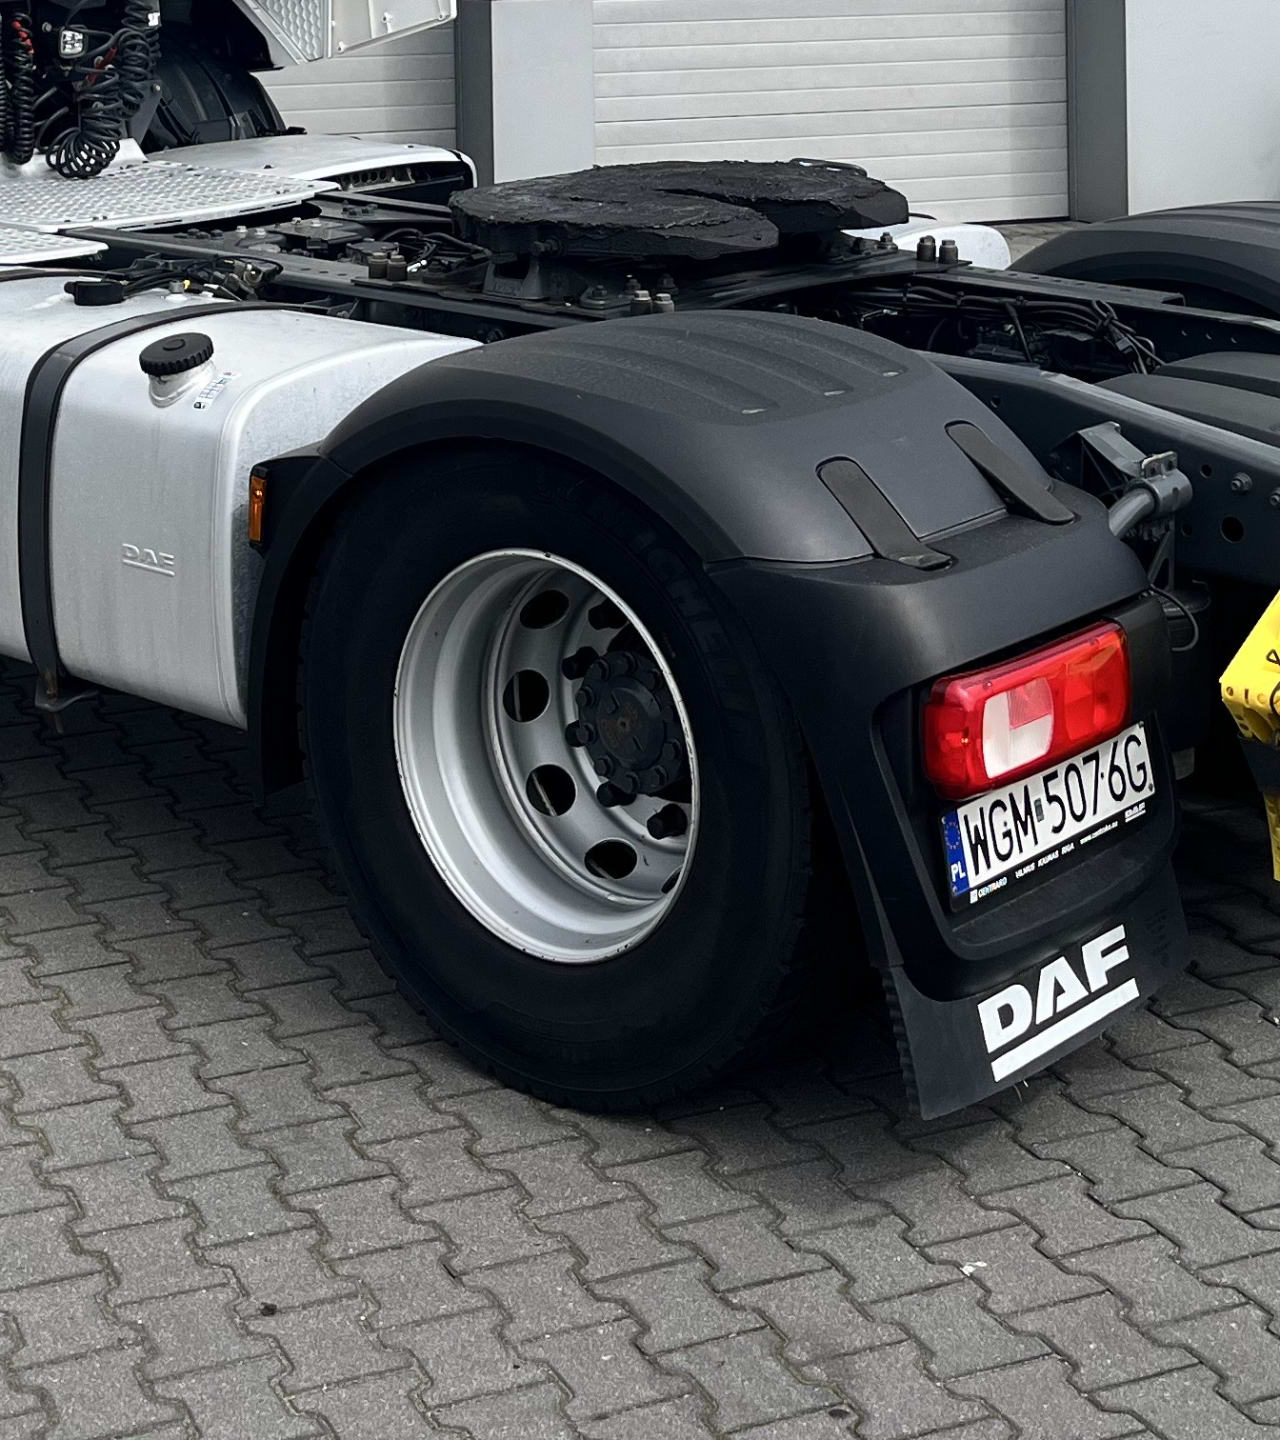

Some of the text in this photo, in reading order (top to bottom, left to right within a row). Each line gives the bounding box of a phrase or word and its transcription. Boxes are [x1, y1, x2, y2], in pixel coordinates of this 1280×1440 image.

[121, 542, 175, 569] DAF
[963, 734, 1148, 876] WGM 5076G
[950, 860, 967, 882] PL
[977, 924, 1130, 1054] DAF
